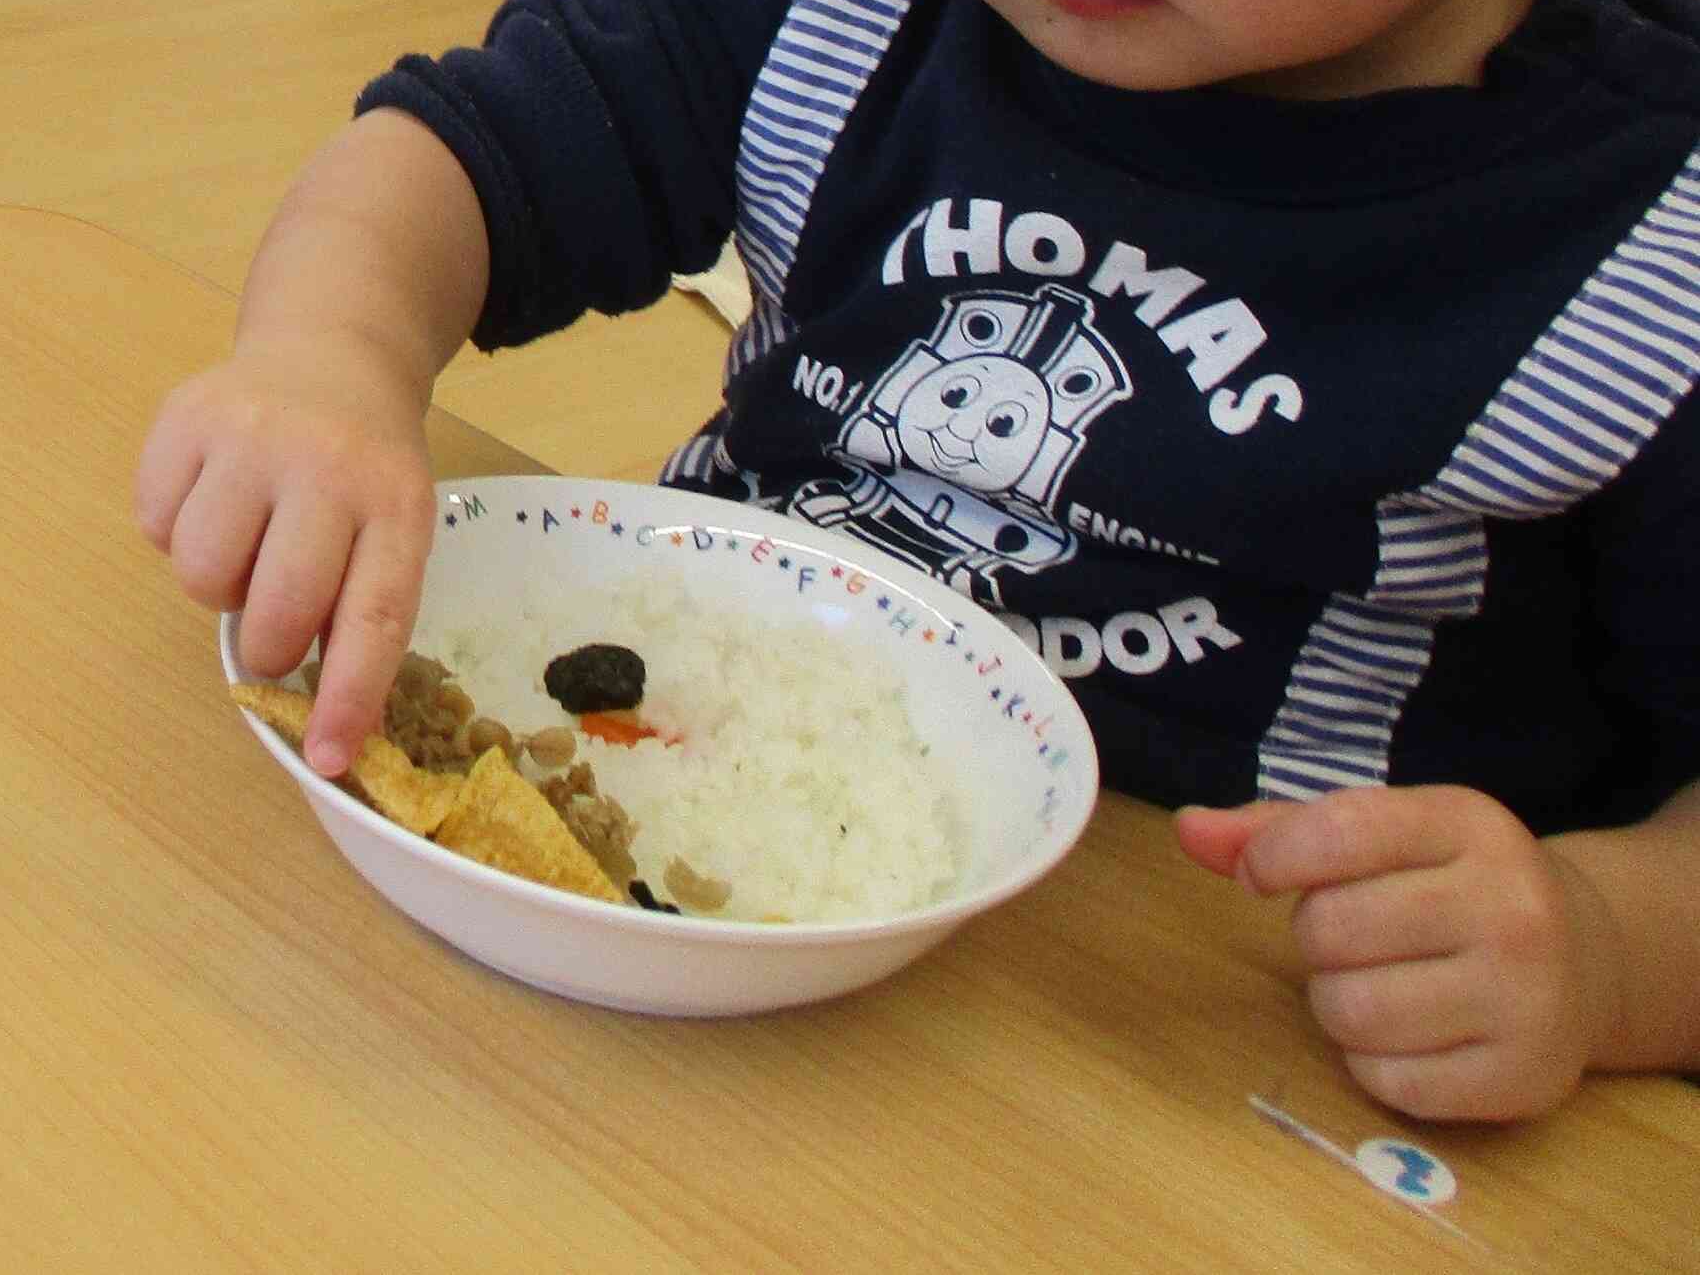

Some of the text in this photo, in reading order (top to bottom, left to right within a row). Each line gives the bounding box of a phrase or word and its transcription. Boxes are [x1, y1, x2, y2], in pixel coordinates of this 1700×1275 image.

[793, 354, 864, 415] NO.1
[459, 492, 488, 521] M
[542, 508, 561, 534] A
[591, 499, 610, 526] B
[690, 524, 714, 551] D
[750, 535, 777, 565] E
[797, 567, 817, 594] F
[845, 572, 870, 595] G
